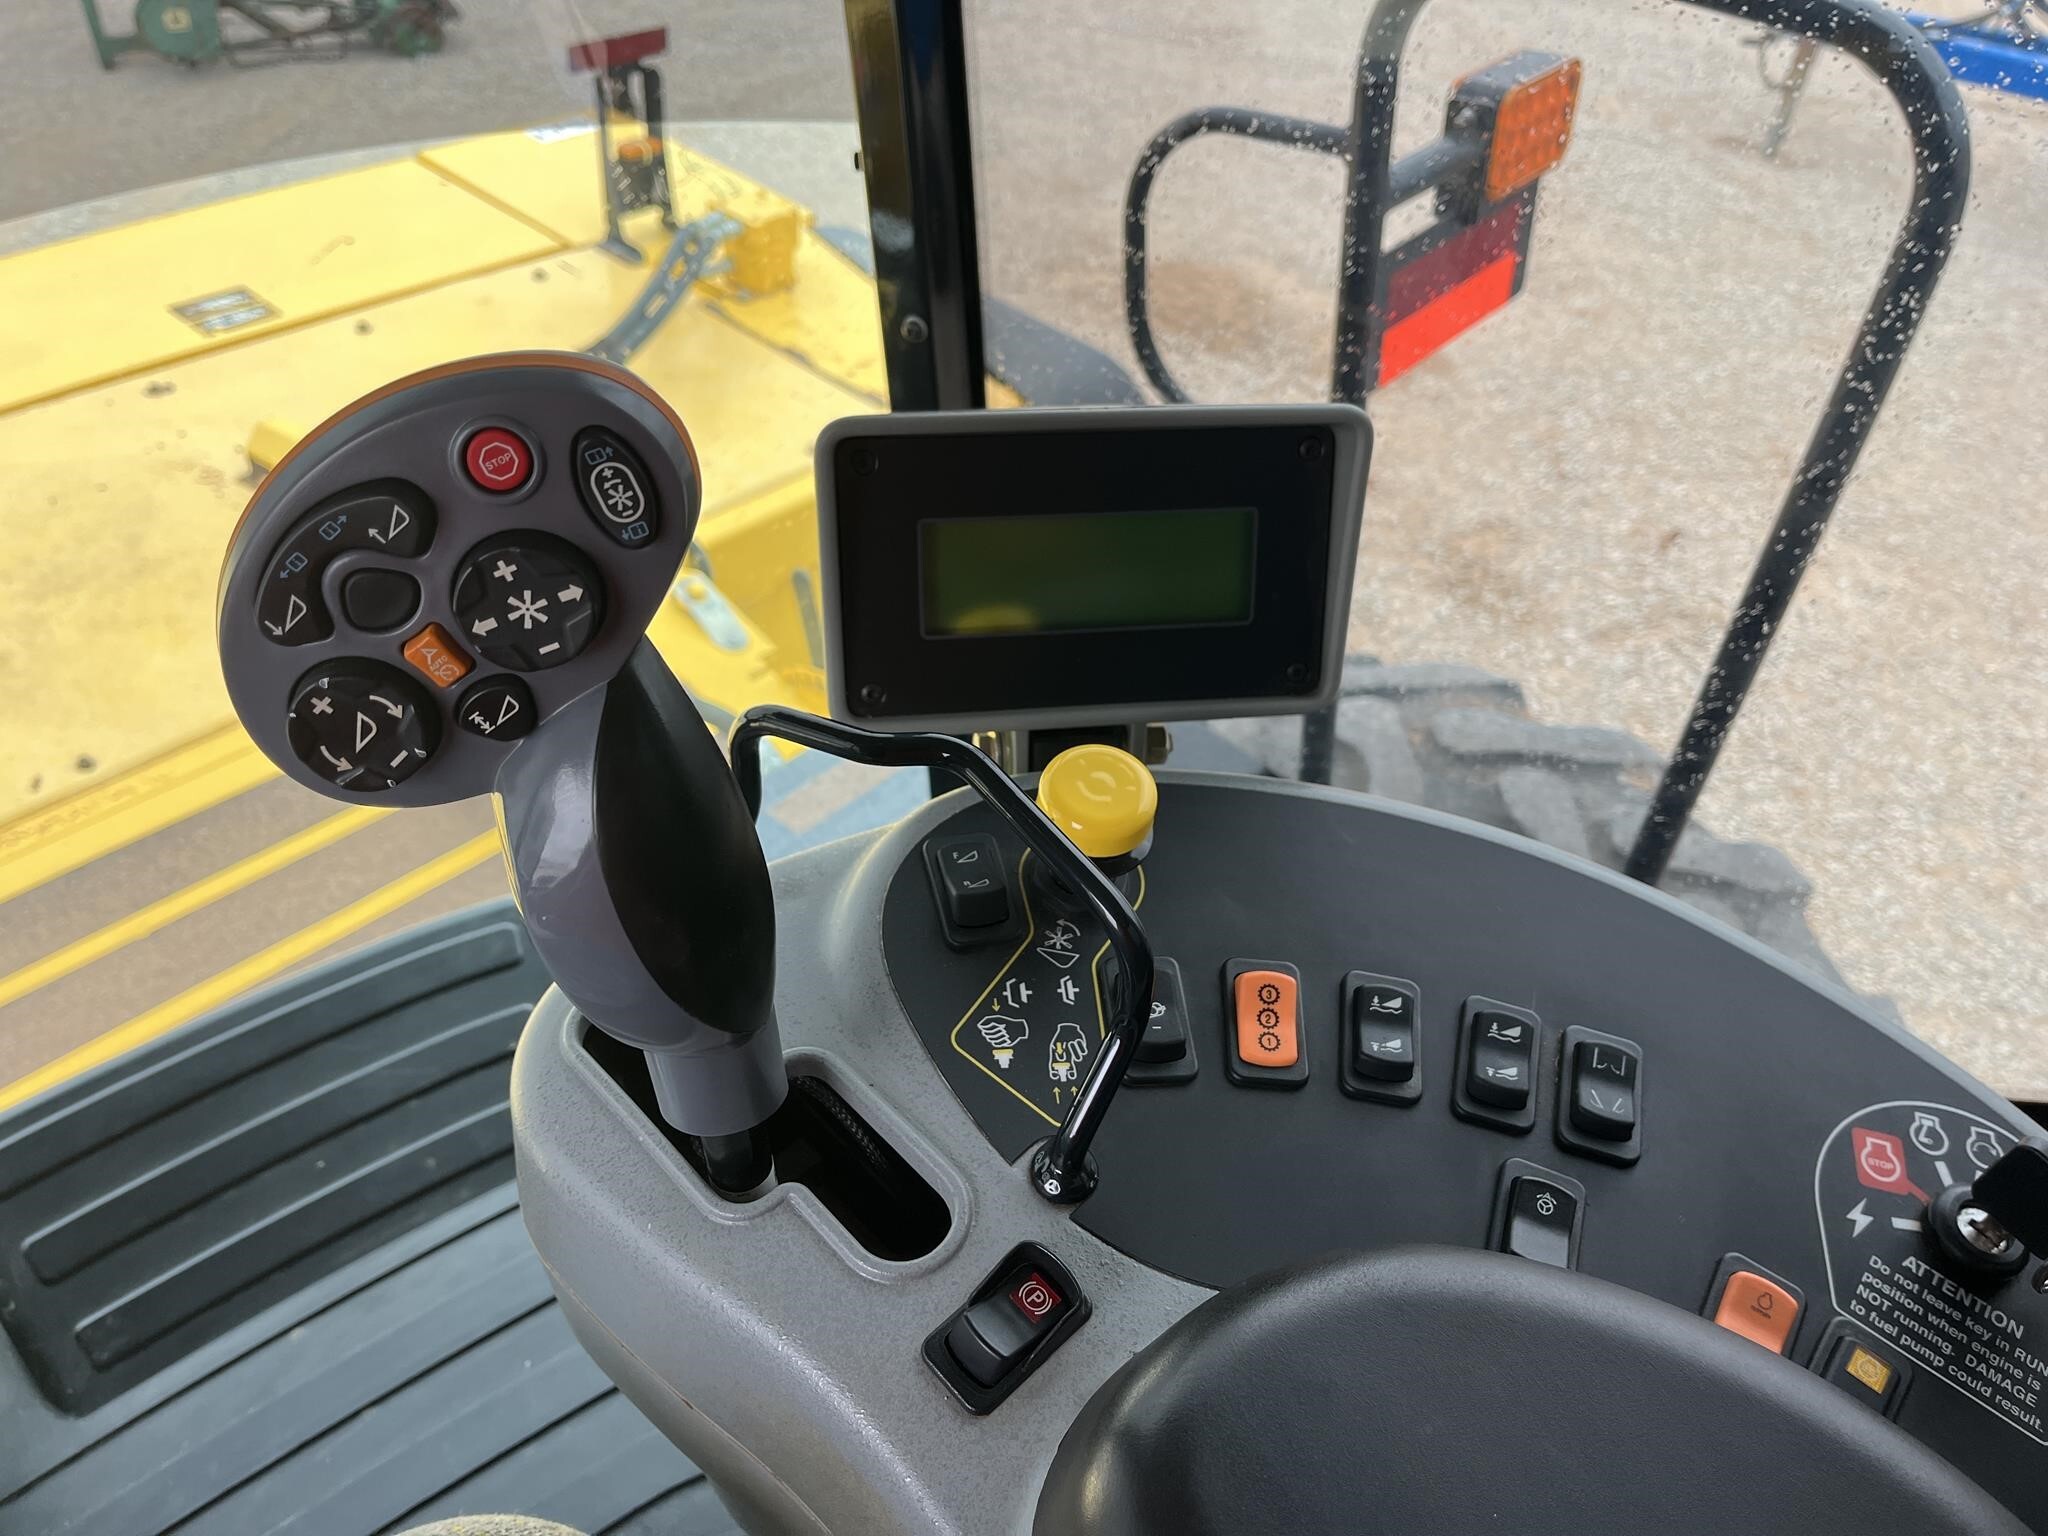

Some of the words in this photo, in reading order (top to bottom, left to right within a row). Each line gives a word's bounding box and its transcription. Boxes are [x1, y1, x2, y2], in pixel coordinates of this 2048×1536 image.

[485, 453, 511, 470] STOP
[1266, 989, 1272, 1000] 3
[1265, 1013, 1271, 1024] 2
[1266, 1037, 1271, 1046] 1
[1867, 1157, 1894, 1170] STOP
[1027, 1290, 1044, 1303] P
[1902, 1256, 2024, 1340] ATTENTION
[1869, 1255, 1891, 1275] Do
[1893, 1273, 1919, 1294] not
[1922, 1289, 1962, 1321] leave
[1965, 1316, 1992, 1341] key
[1996, 1335, 2010, 1351] in
[2014, 1347, 2048, 1377] RUN
[1861, 1272, 1924, 1316] position
[1928, 1312, 1968, 1344] when
[1971, 1341, 2024, 1379] engine
[2027, 1374, 2041, 1391] is
[1856, 1284, 1893, 1311] NOT
[1893, 1310, 1955, 1356] running.
[1965, 1353, 2038, 1408] DAMAGE
[1850, 1299, 1866, 1316] to
[1868, 1311, 1899, 1337] fuel
[1900, 1333, 1945, 1367] pump
[1948, 1365, 1992, 1398] could
[1995, 1394, 2044, 1433] result.
